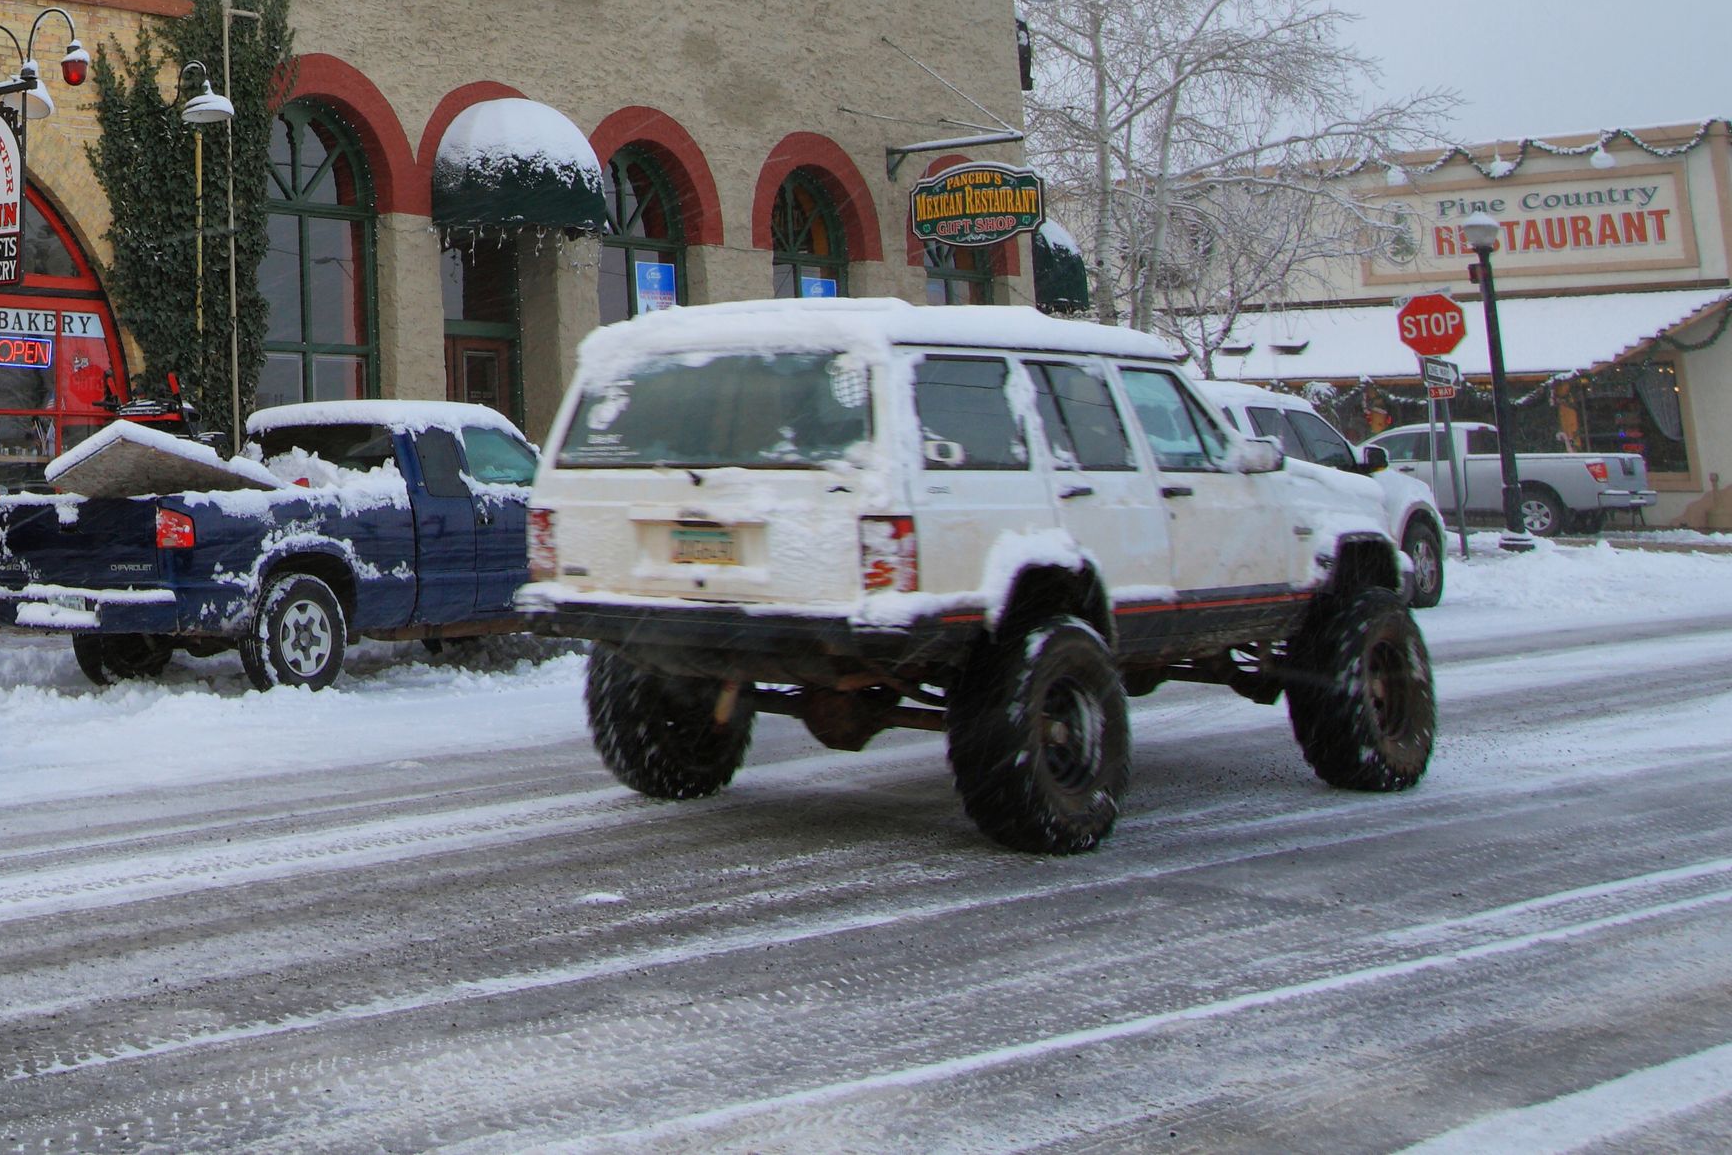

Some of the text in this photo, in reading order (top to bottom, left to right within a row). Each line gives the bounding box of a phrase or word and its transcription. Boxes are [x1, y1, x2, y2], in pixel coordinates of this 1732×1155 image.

[946, 172, 1002, 190] PANCHO'S
[916, 184, 1037, 222] MEXICAN RESTAURANT
[1436, 186, 1660, 216] Pine Country
[936, 216, 1016, 236] GIFT SHOP
[1433, 209, 1670, 257] RTAURANT
[1402, 312, 1460, 338] STOP
[1428, 364, 1438, 375] ONE
[1430, 387, 1452, 398] 3-WAY
[110, 564, 152, 572] CHEVROLET
